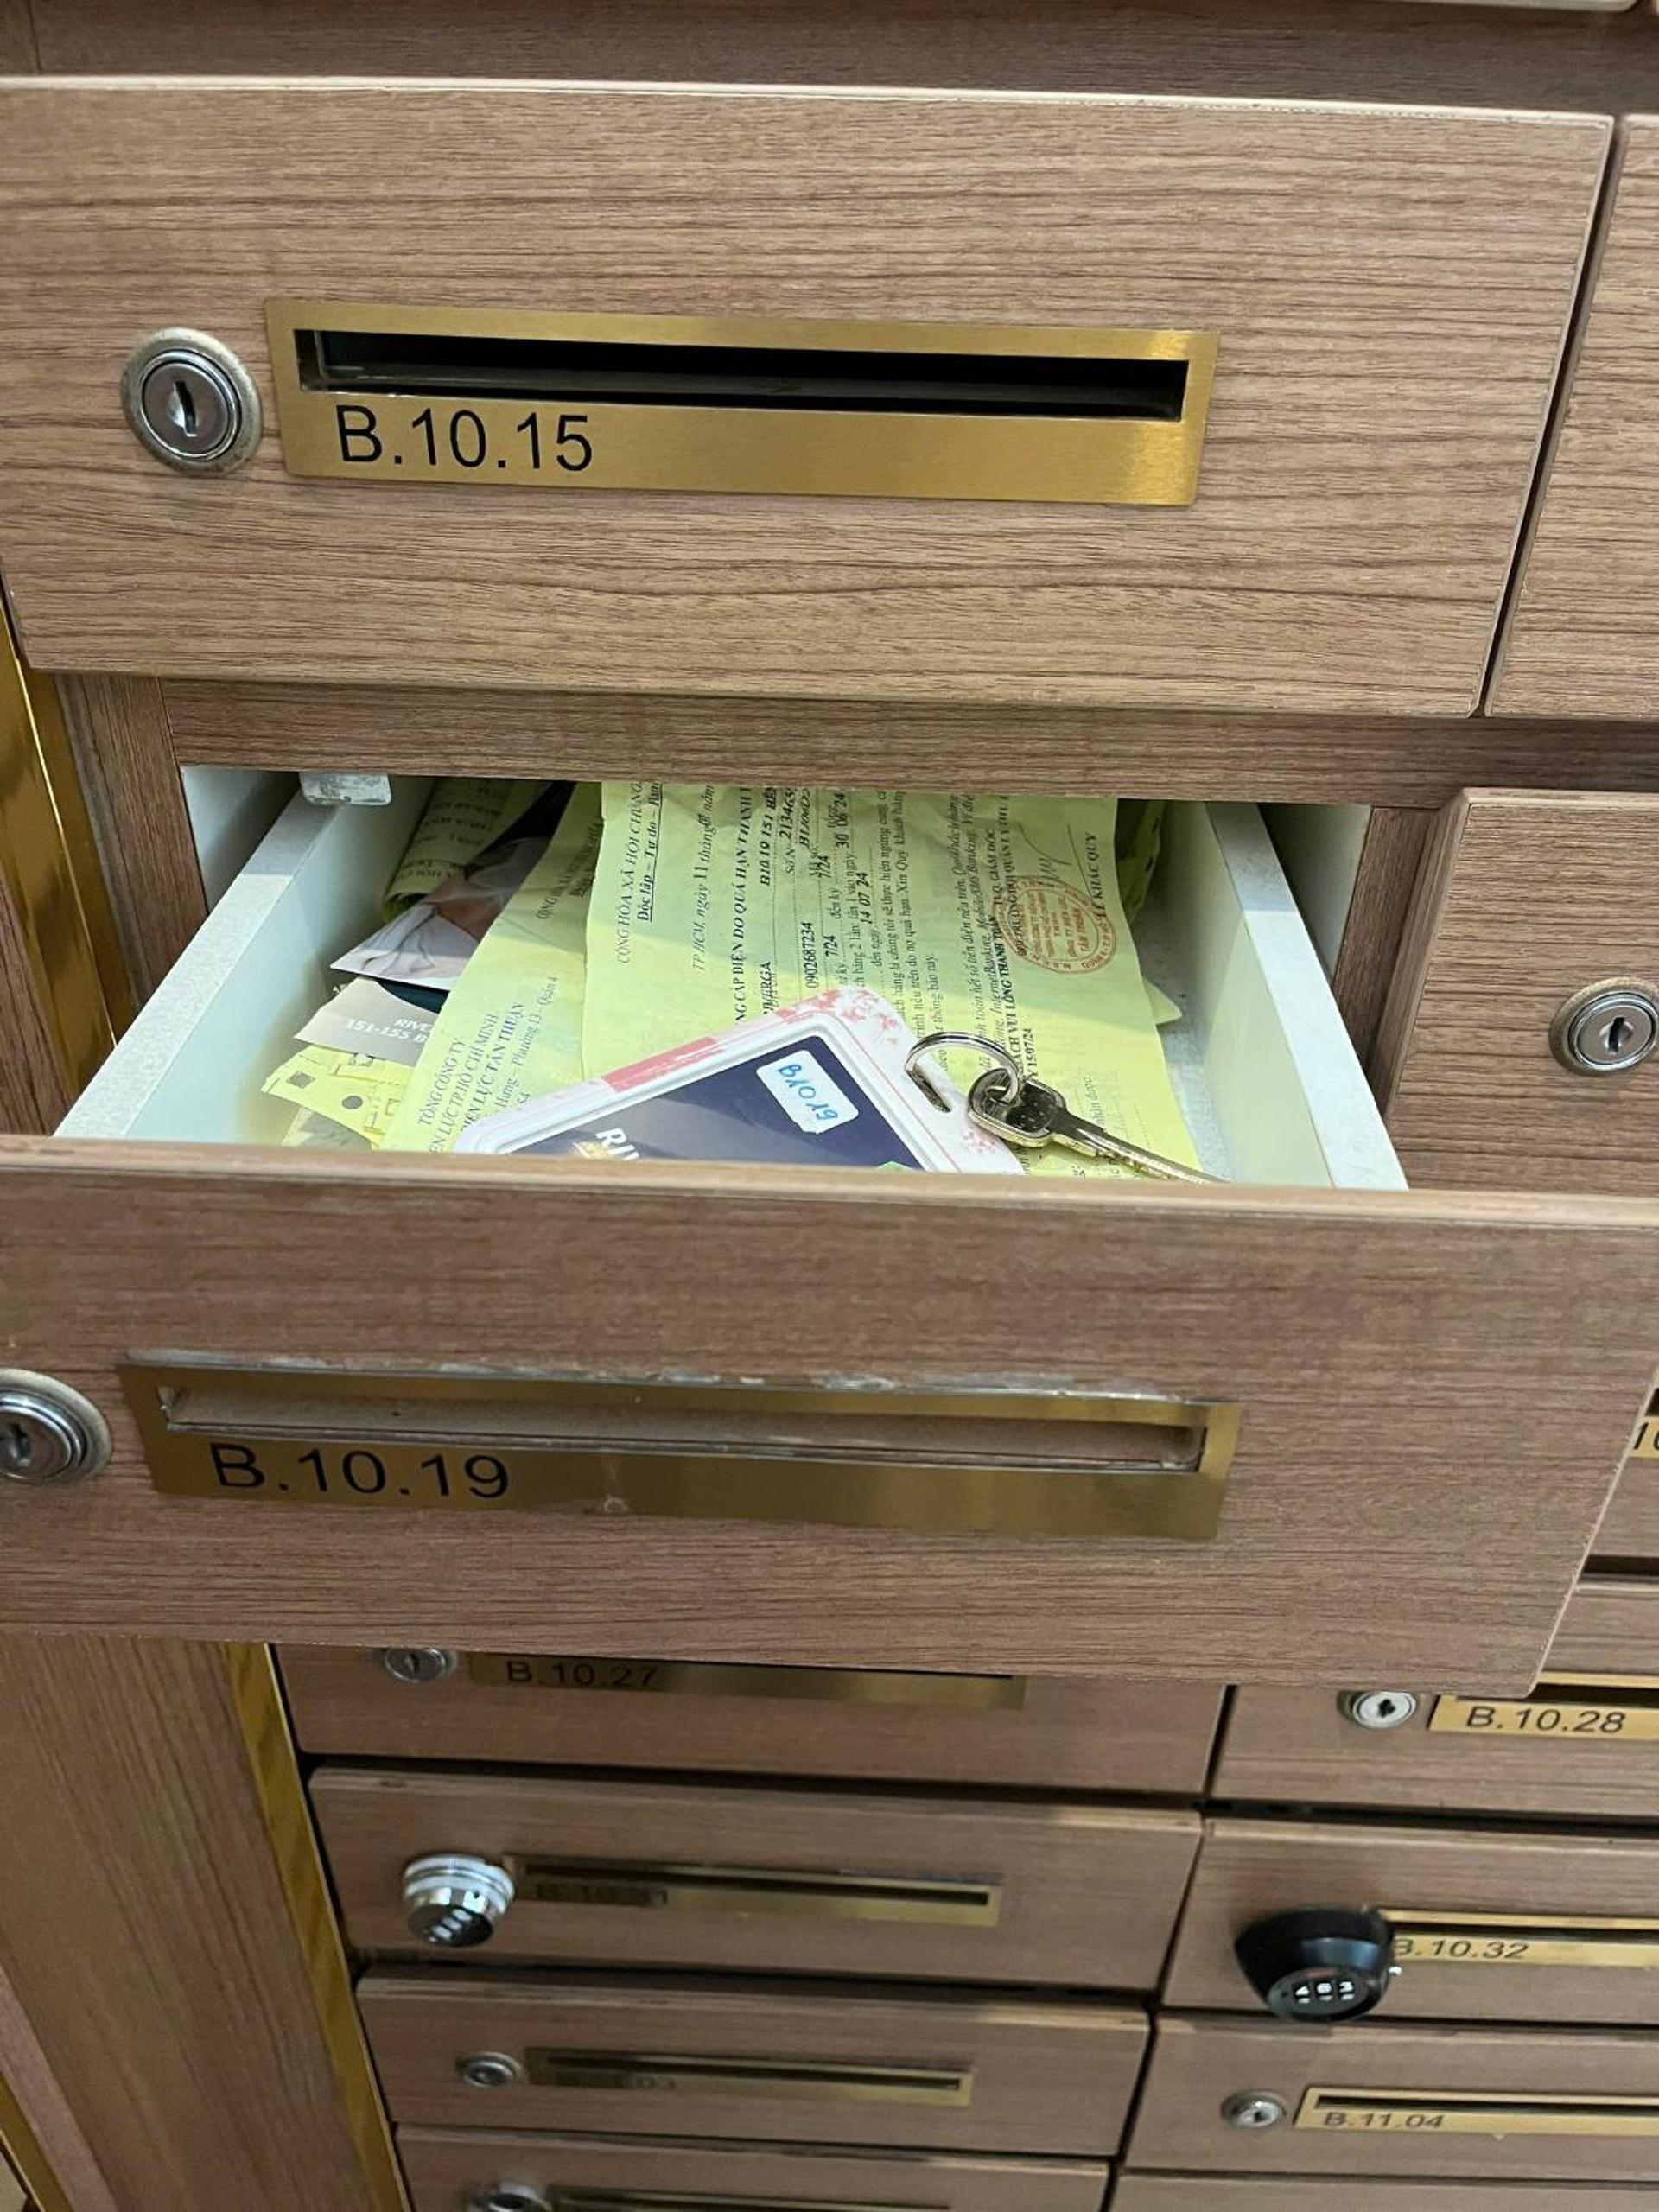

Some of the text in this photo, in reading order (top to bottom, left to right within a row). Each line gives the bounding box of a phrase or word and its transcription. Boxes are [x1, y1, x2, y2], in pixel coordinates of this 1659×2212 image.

[334, 404, 594, 473] B.10.15
[800, 921, 819, 989] 0902687234
[209, 1442, 510, 1499] B.10.19
[1465, 1706, 1626, 1734] B.10.28
[1323, 2111, 1445, 2129] B.11.04
